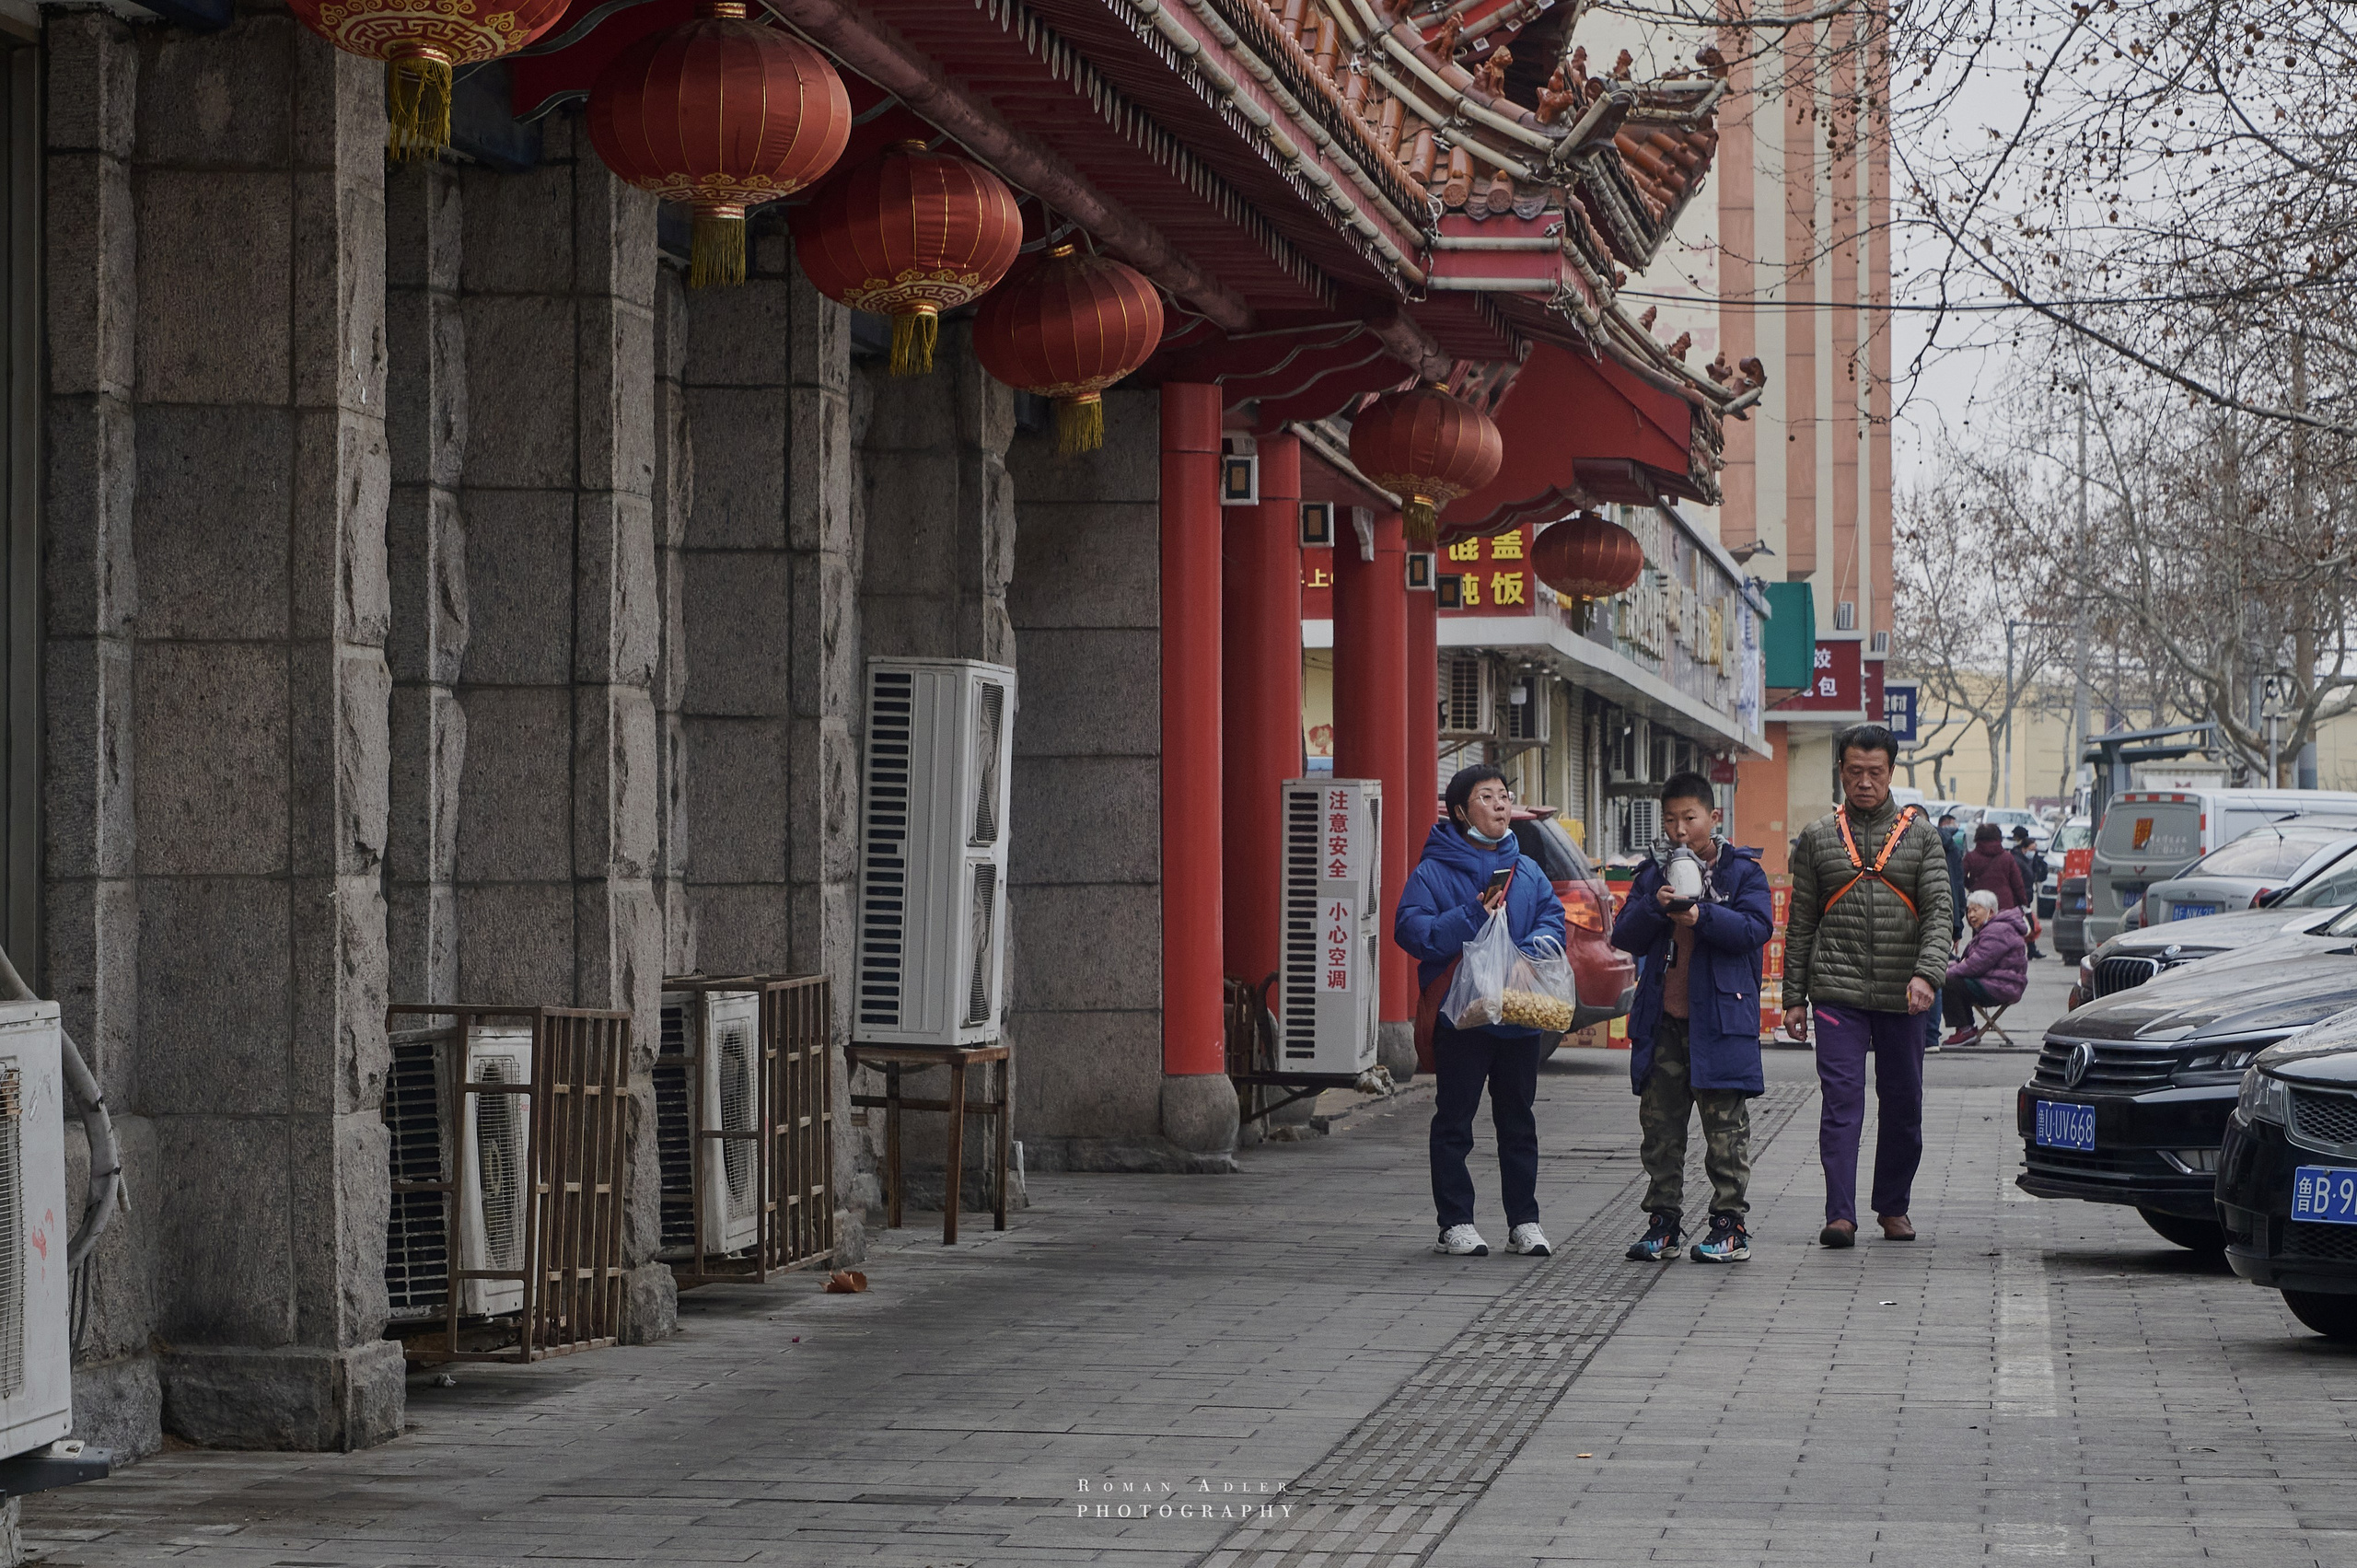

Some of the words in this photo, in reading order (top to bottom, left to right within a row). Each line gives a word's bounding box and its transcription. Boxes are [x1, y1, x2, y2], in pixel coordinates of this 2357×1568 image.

[1491, 529, 1525, 605] 盖饭
[1328, 790, 1349, 879] 注意安全
[1327, 901, 1348, 990] 小心空调
[2297, 1176, 2357, 1215] 鲁B·9
